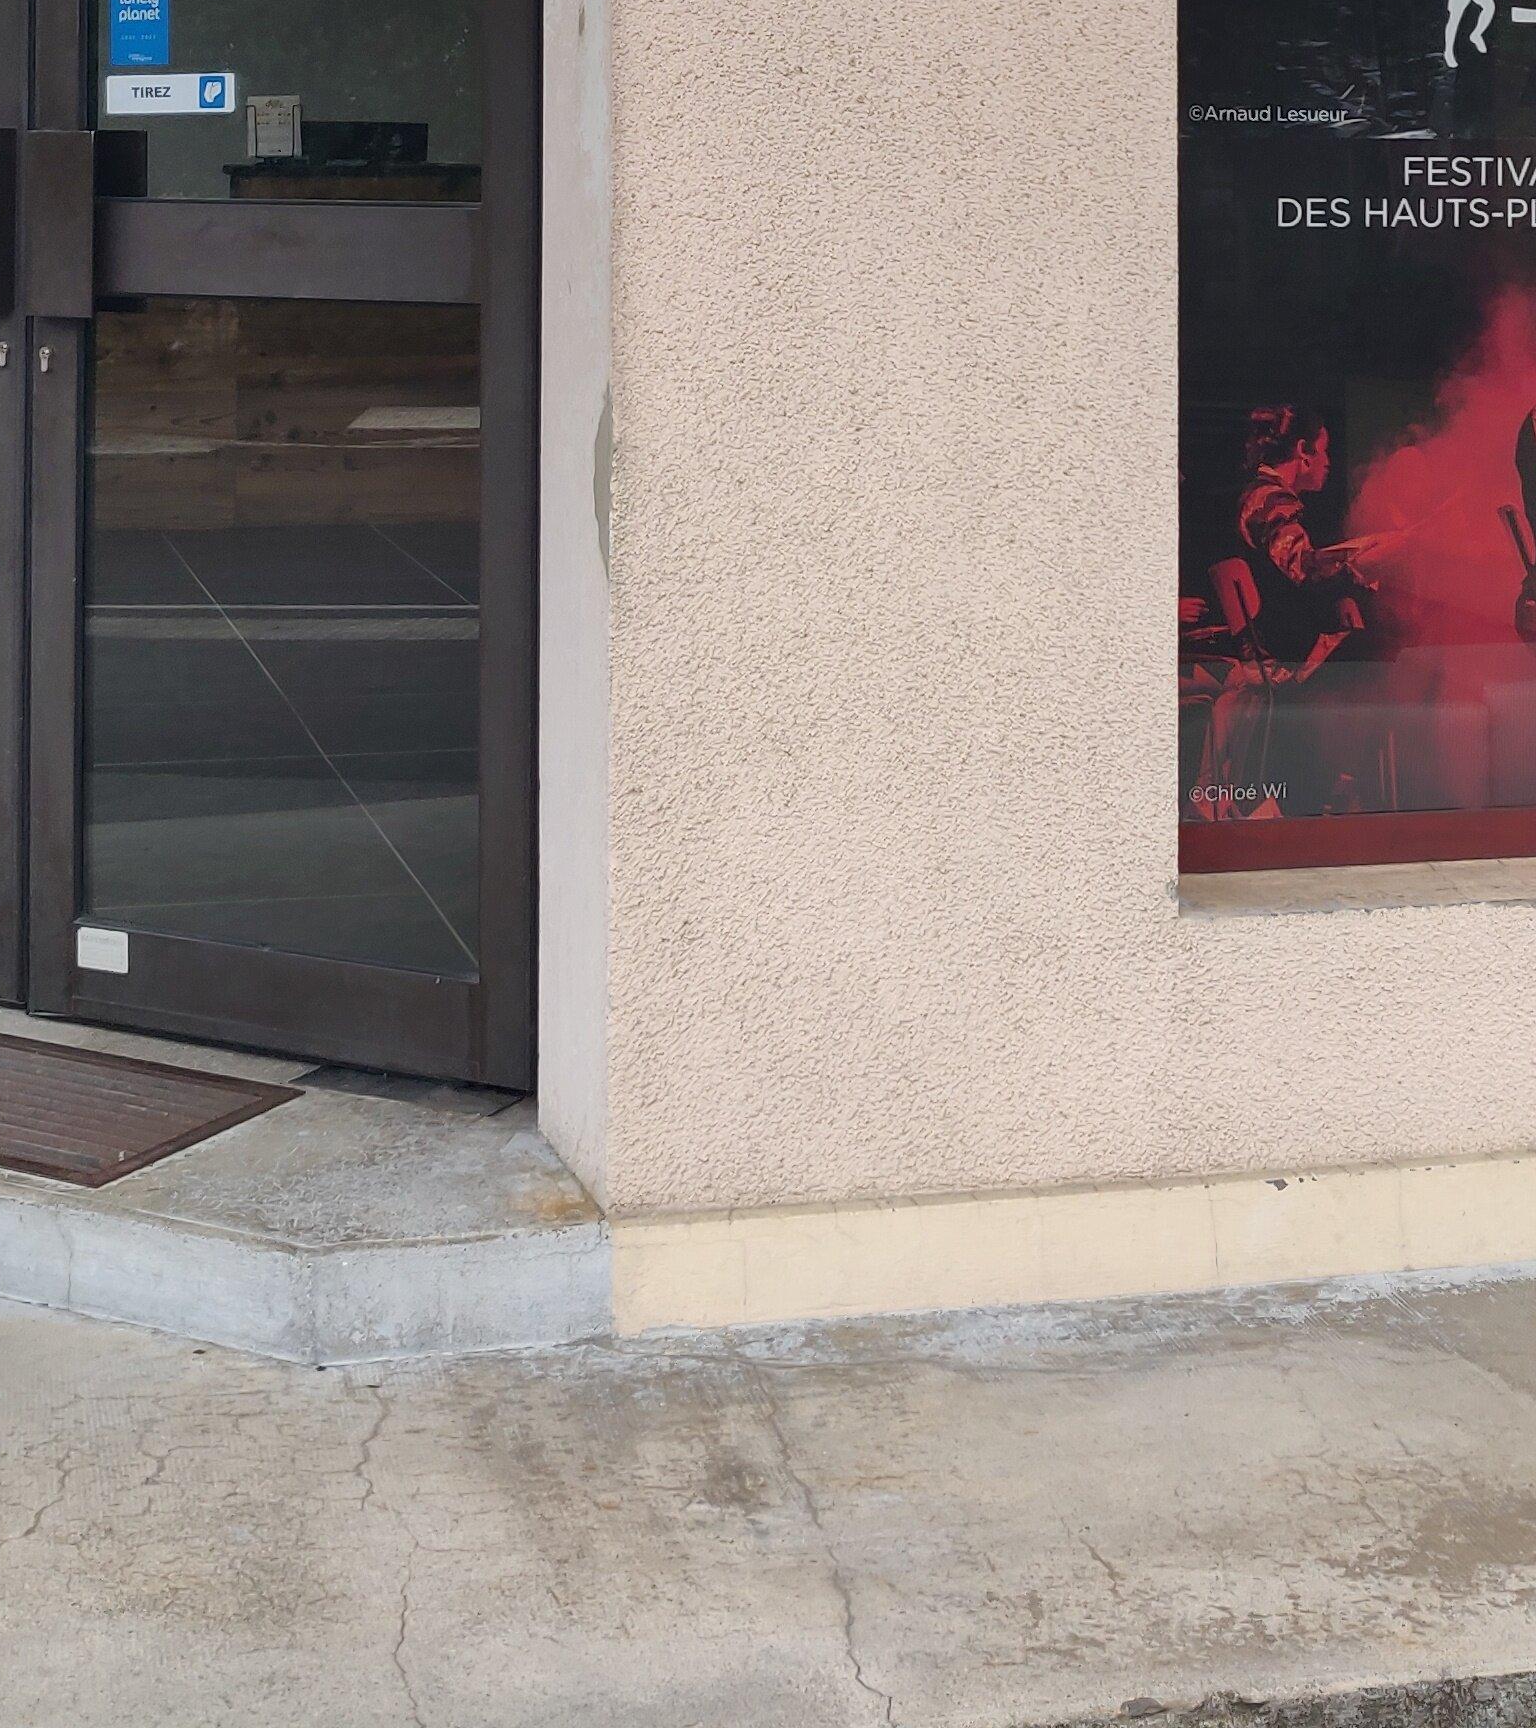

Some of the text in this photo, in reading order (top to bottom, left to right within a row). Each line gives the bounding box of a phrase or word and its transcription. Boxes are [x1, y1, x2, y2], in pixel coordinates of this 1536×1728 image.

[118, 6, 161, 23] planet
[131, 87, 172, 99] TIREZ
[1276, 105, 1348, 124] Lesueur
[1276, 198, 1351, 227] DES
